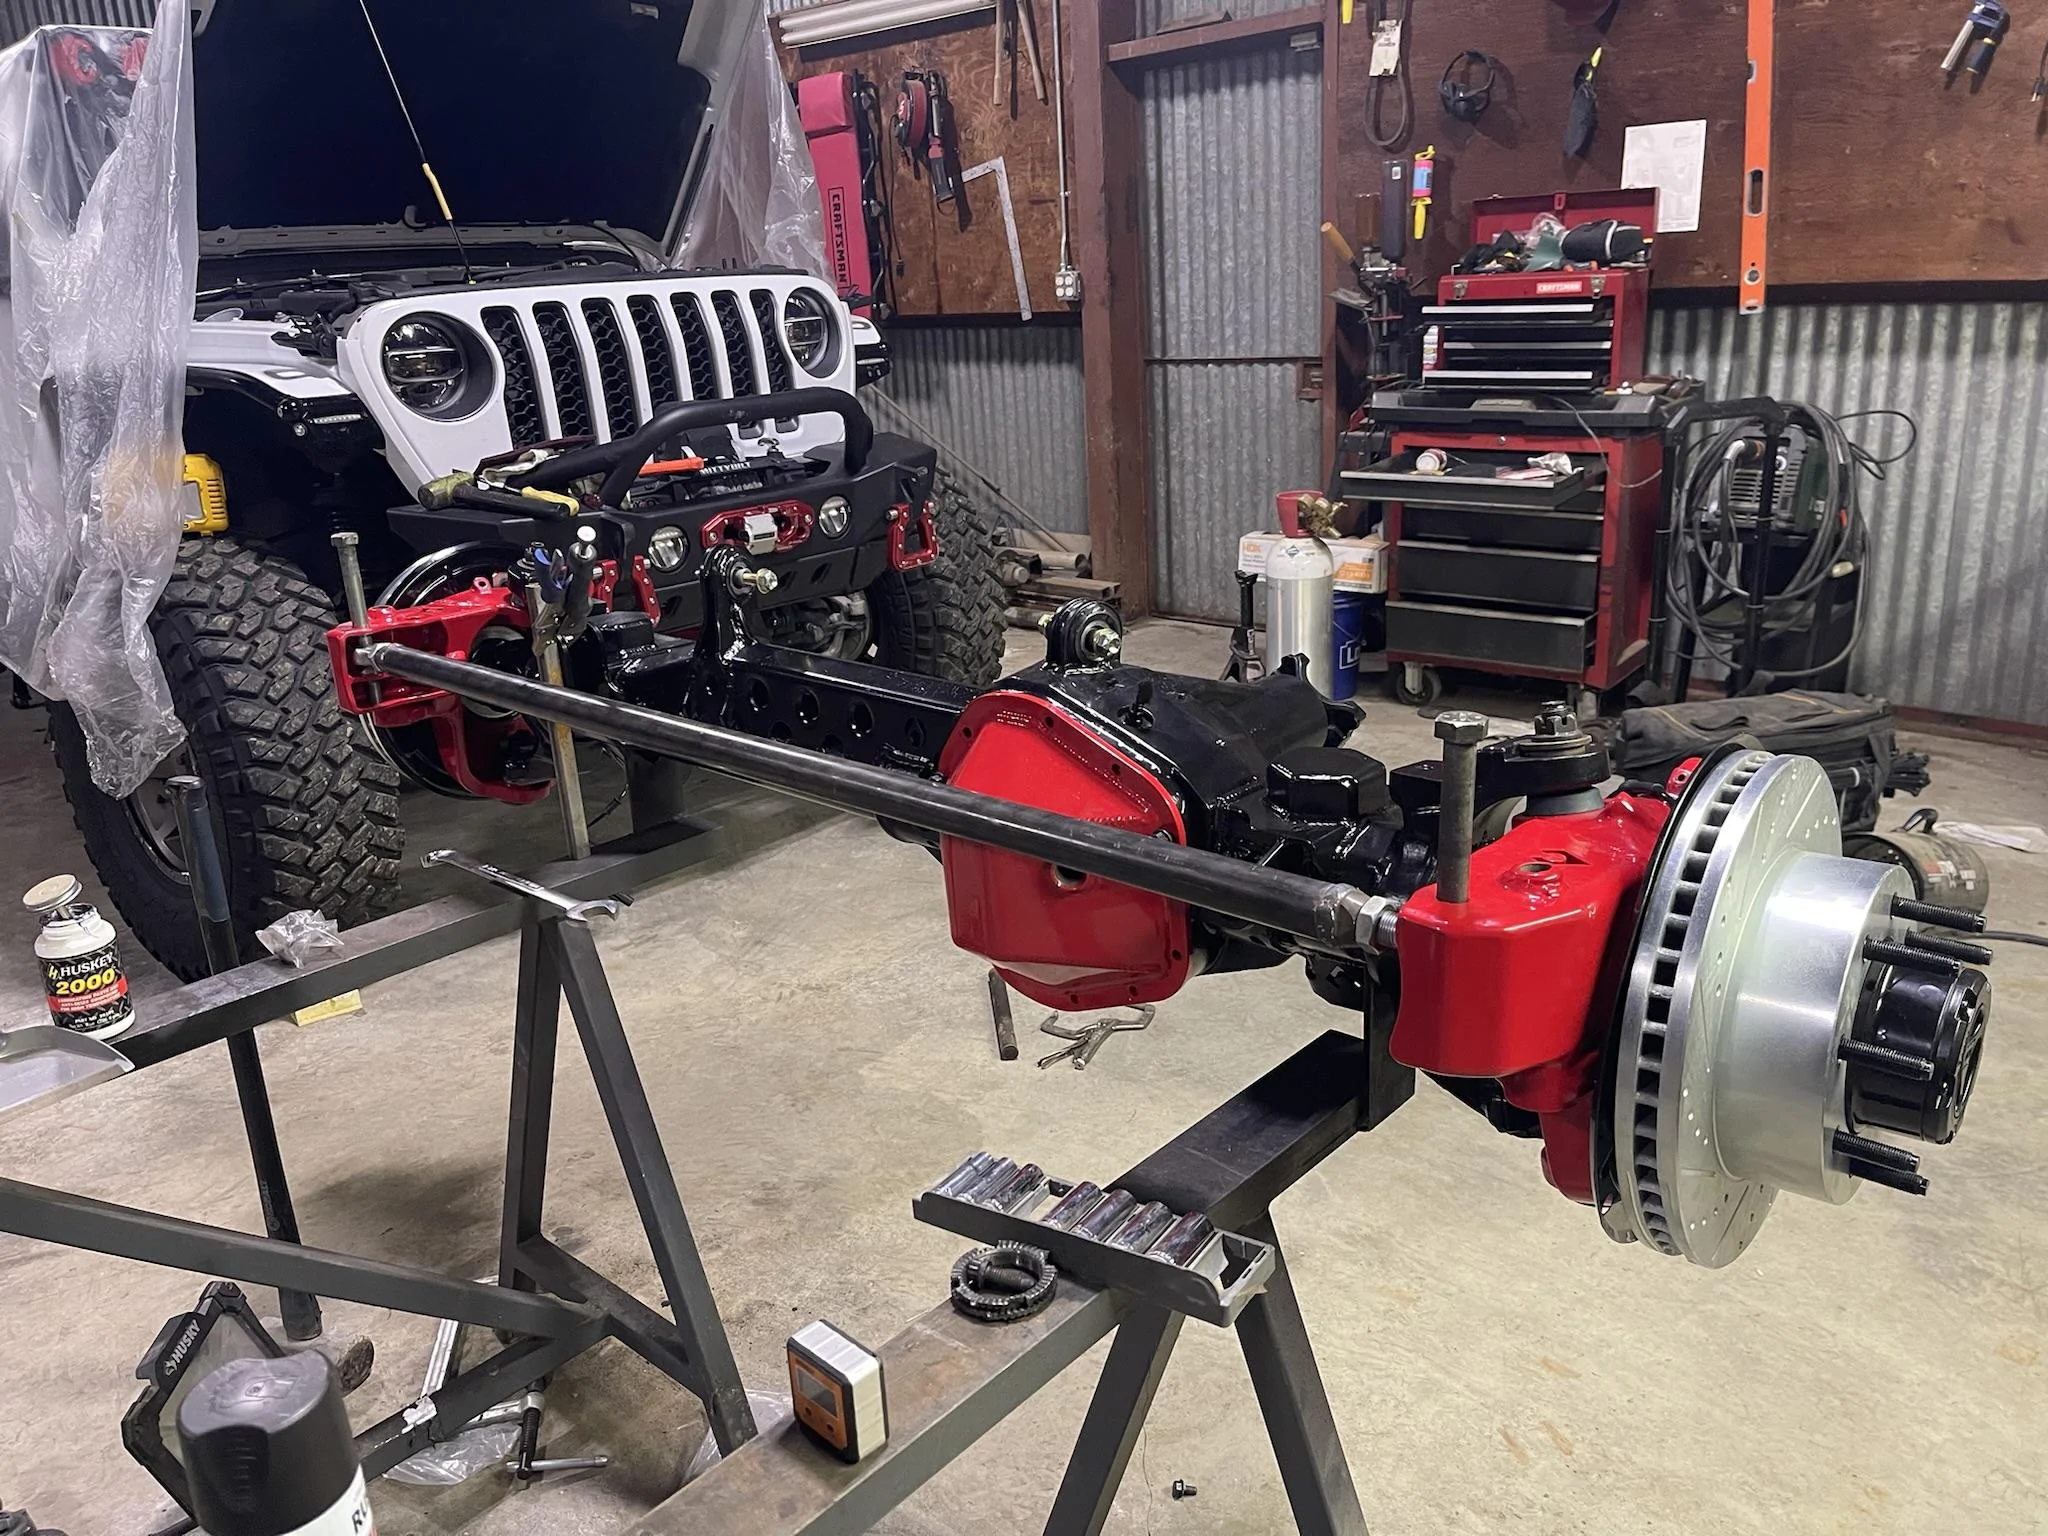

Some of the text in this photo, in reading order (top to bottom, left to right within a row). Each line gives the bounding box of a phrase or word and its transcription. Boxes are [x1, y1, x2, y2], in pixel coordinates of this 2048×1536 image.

[832, 193, 847, 283] CRAFTSMAN
[56, 967, 116, 995] 2000
[60, 951, 114, 977] HUSKEY
[171, 1319, 201, 1364] HUSKY
